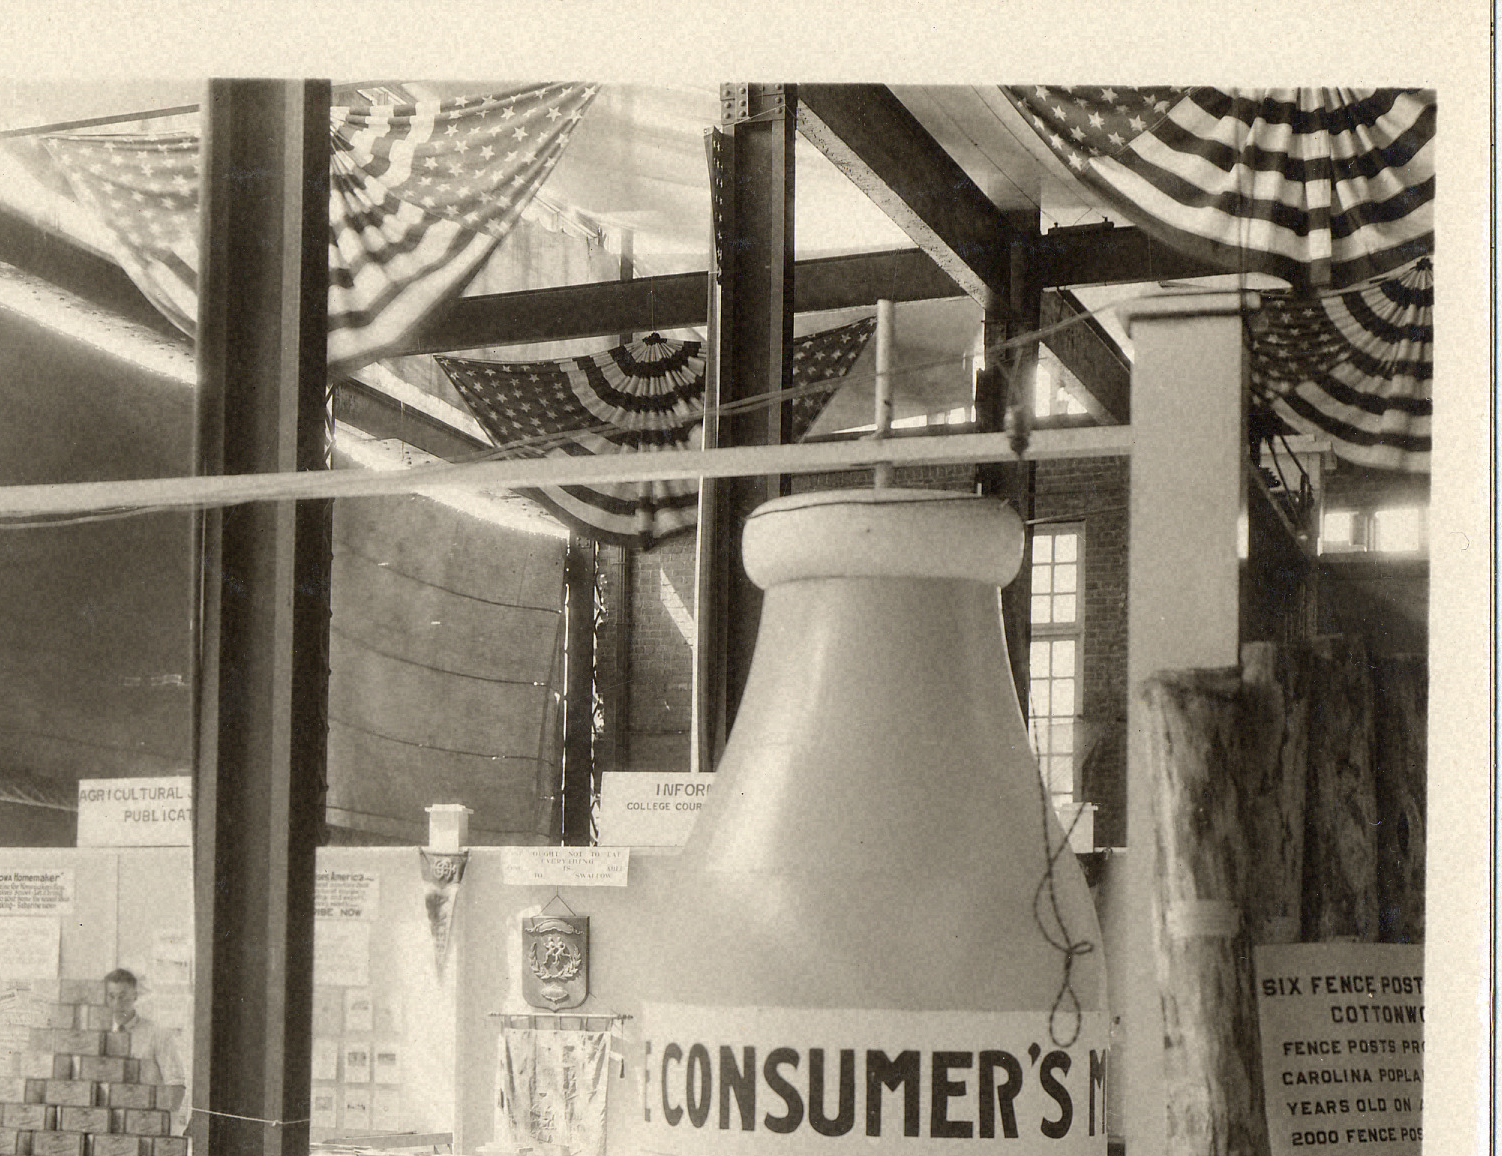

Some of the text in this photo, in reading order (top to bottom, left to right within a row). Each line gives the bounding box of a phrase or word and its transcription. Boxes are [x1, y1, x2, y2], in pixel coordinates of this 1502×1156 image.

[79, 787, 183, 801] AGRICULTURAL
[626, 802, 671, 811] COLLEGE
[340, 908, 362, 917] NOW
[1262, 975, 1423, 996] SIX FENCE POST
[1283, 1039, 1424, 1056] FENCE POSTS PR
[1282, 1069, 1424, 1085] CAROLINA POPLA
[661, 1042, 1074, 1140] CONSUMER'S
[1287, 1100, 1350, 1116] YEARS
[1356, 1098, 1387, 1113] OLD
[1394, 1098, 1412, 1112] ON
[1292, 1131, 1339, 1146] 2000
[1347, 1128, 1397, 1143] FENCE
